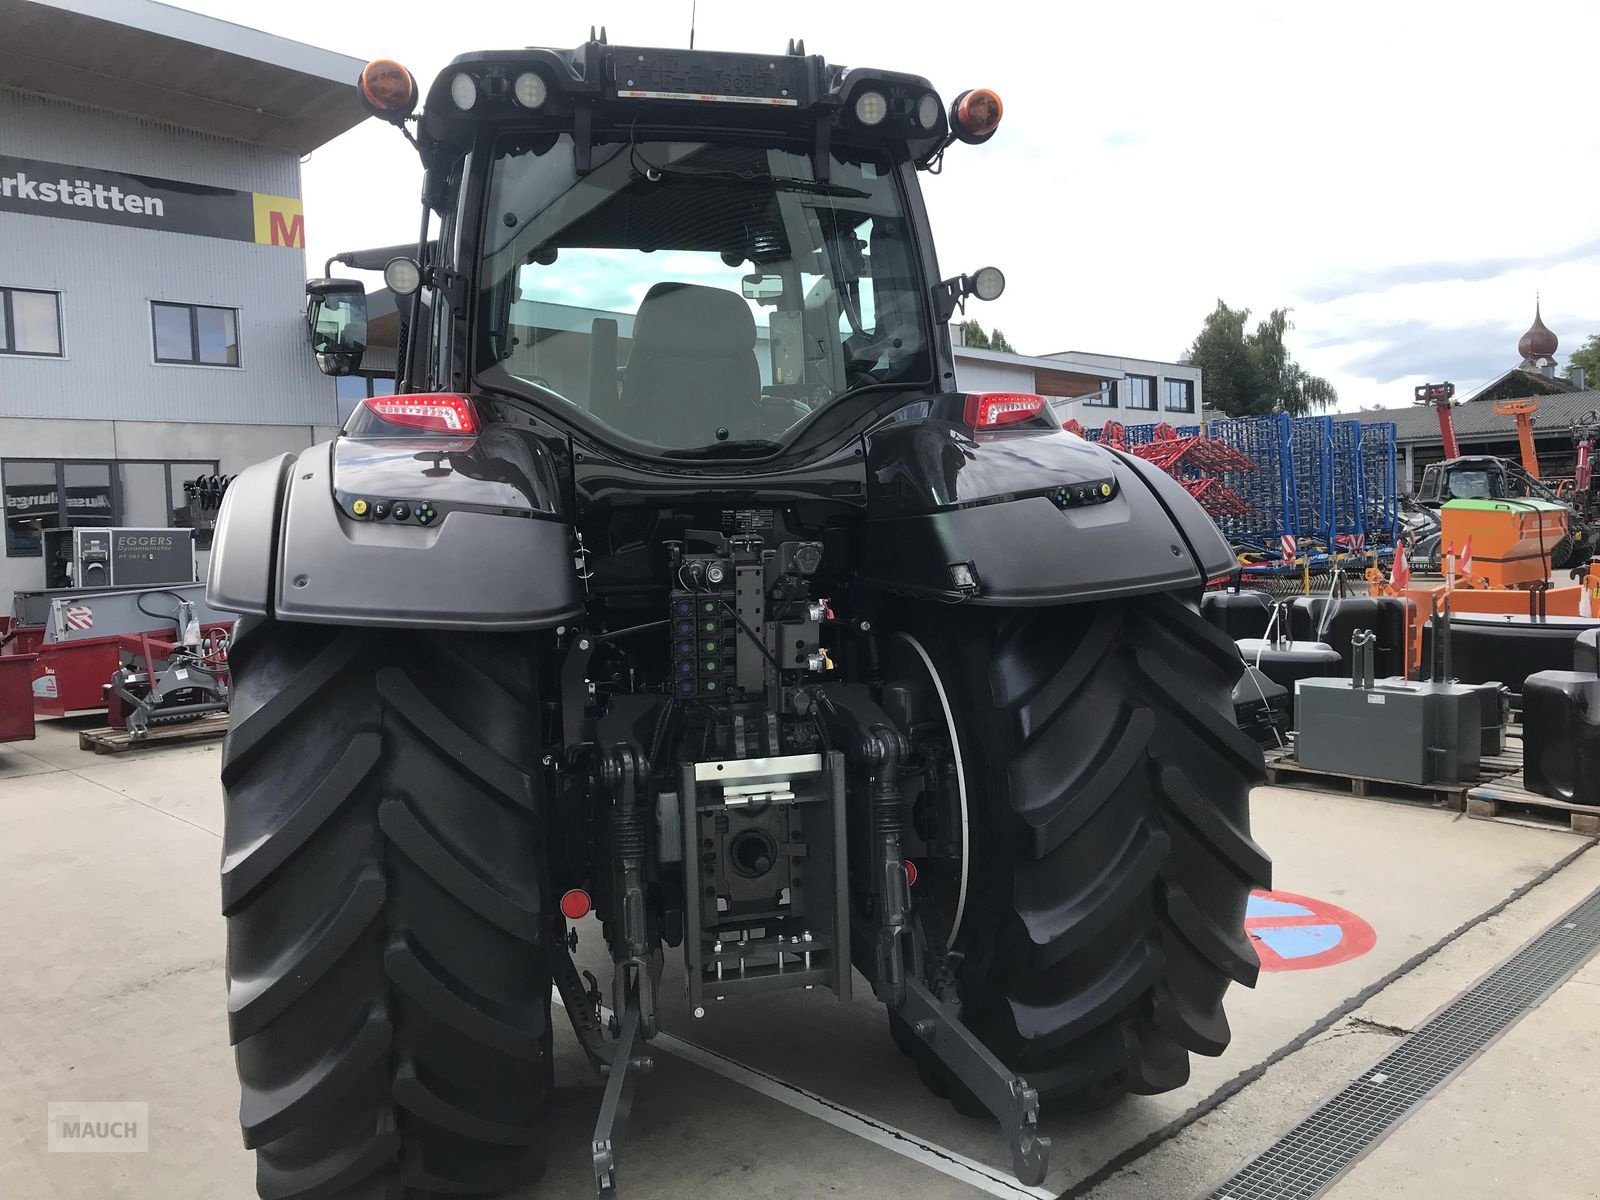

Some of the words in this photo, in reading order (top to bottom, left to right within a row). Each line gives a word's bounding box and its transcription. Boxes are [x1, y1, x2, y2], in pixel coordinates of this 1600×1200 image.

[0, 172, 164, 217] rkstätten
[269, 210, 305, 249] M
[118, 536, 173, 546] EGGERS
